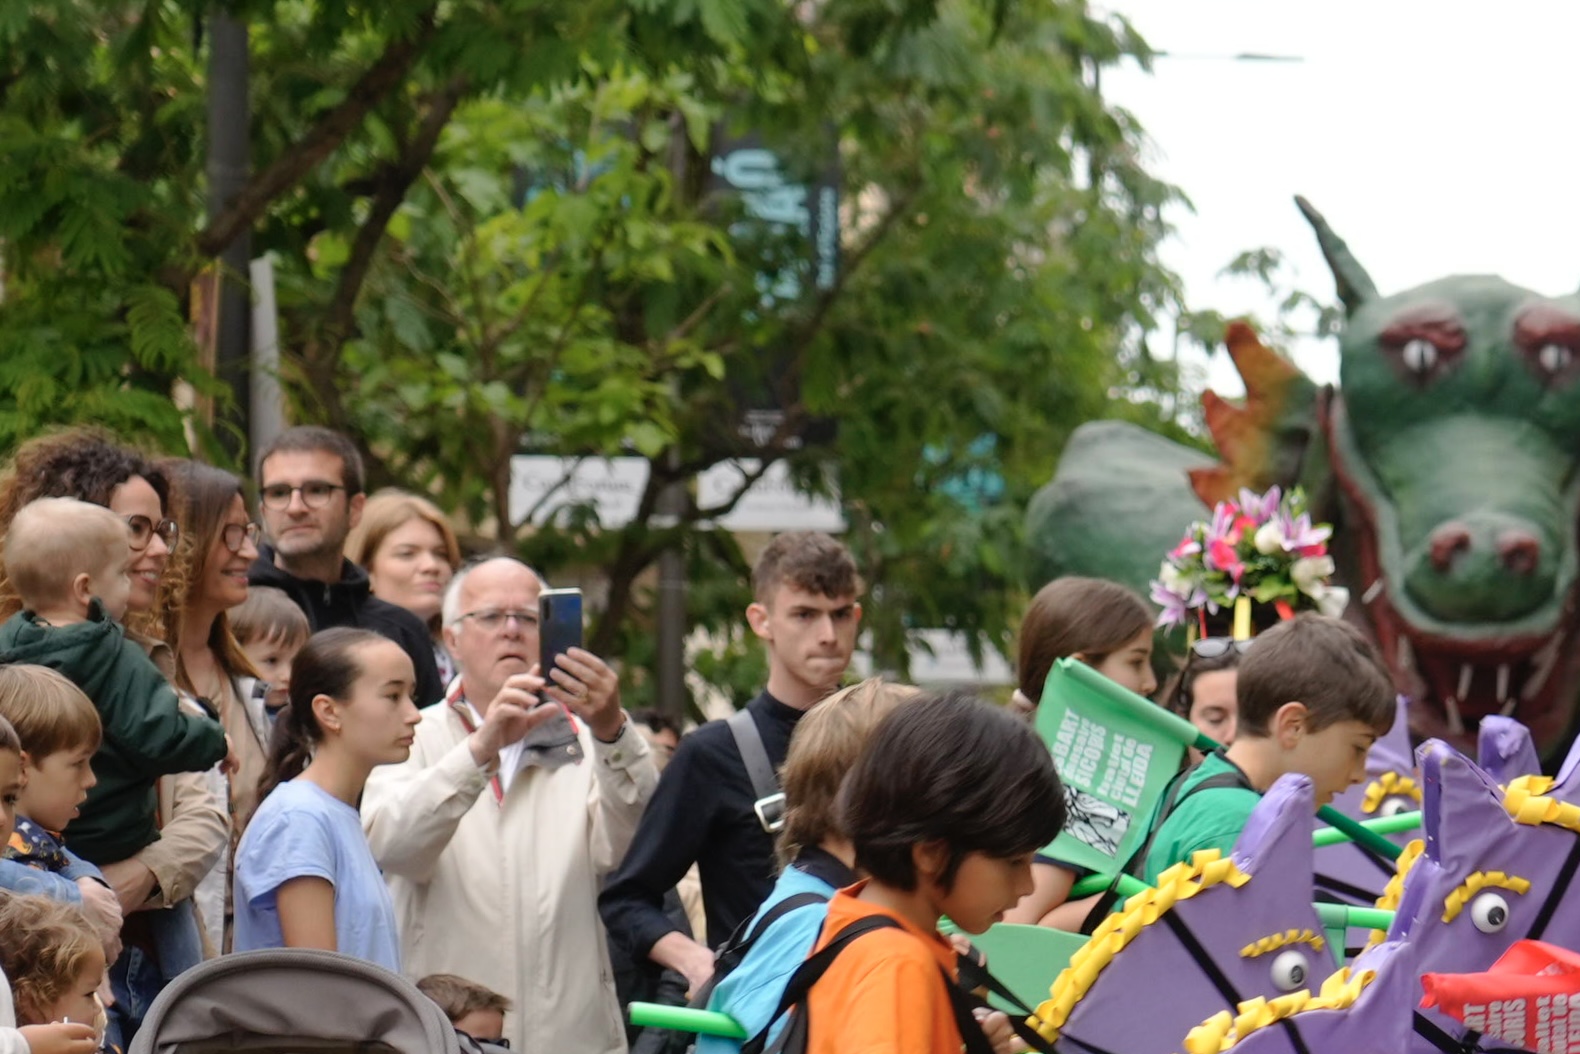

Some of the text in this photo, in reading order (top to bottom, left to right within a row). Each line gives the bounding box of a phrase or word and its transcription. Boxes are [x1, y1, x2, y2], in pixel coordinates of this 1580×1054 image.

[1052, 707, 1080, 776] SBART
[1075, 722, 1107, 787] SICORIS
[1122, 737, 1138, 760] de
[1121, 742, 1154, 808] LLEIDA
[1503, 997, 1527, 1049] ORIS
